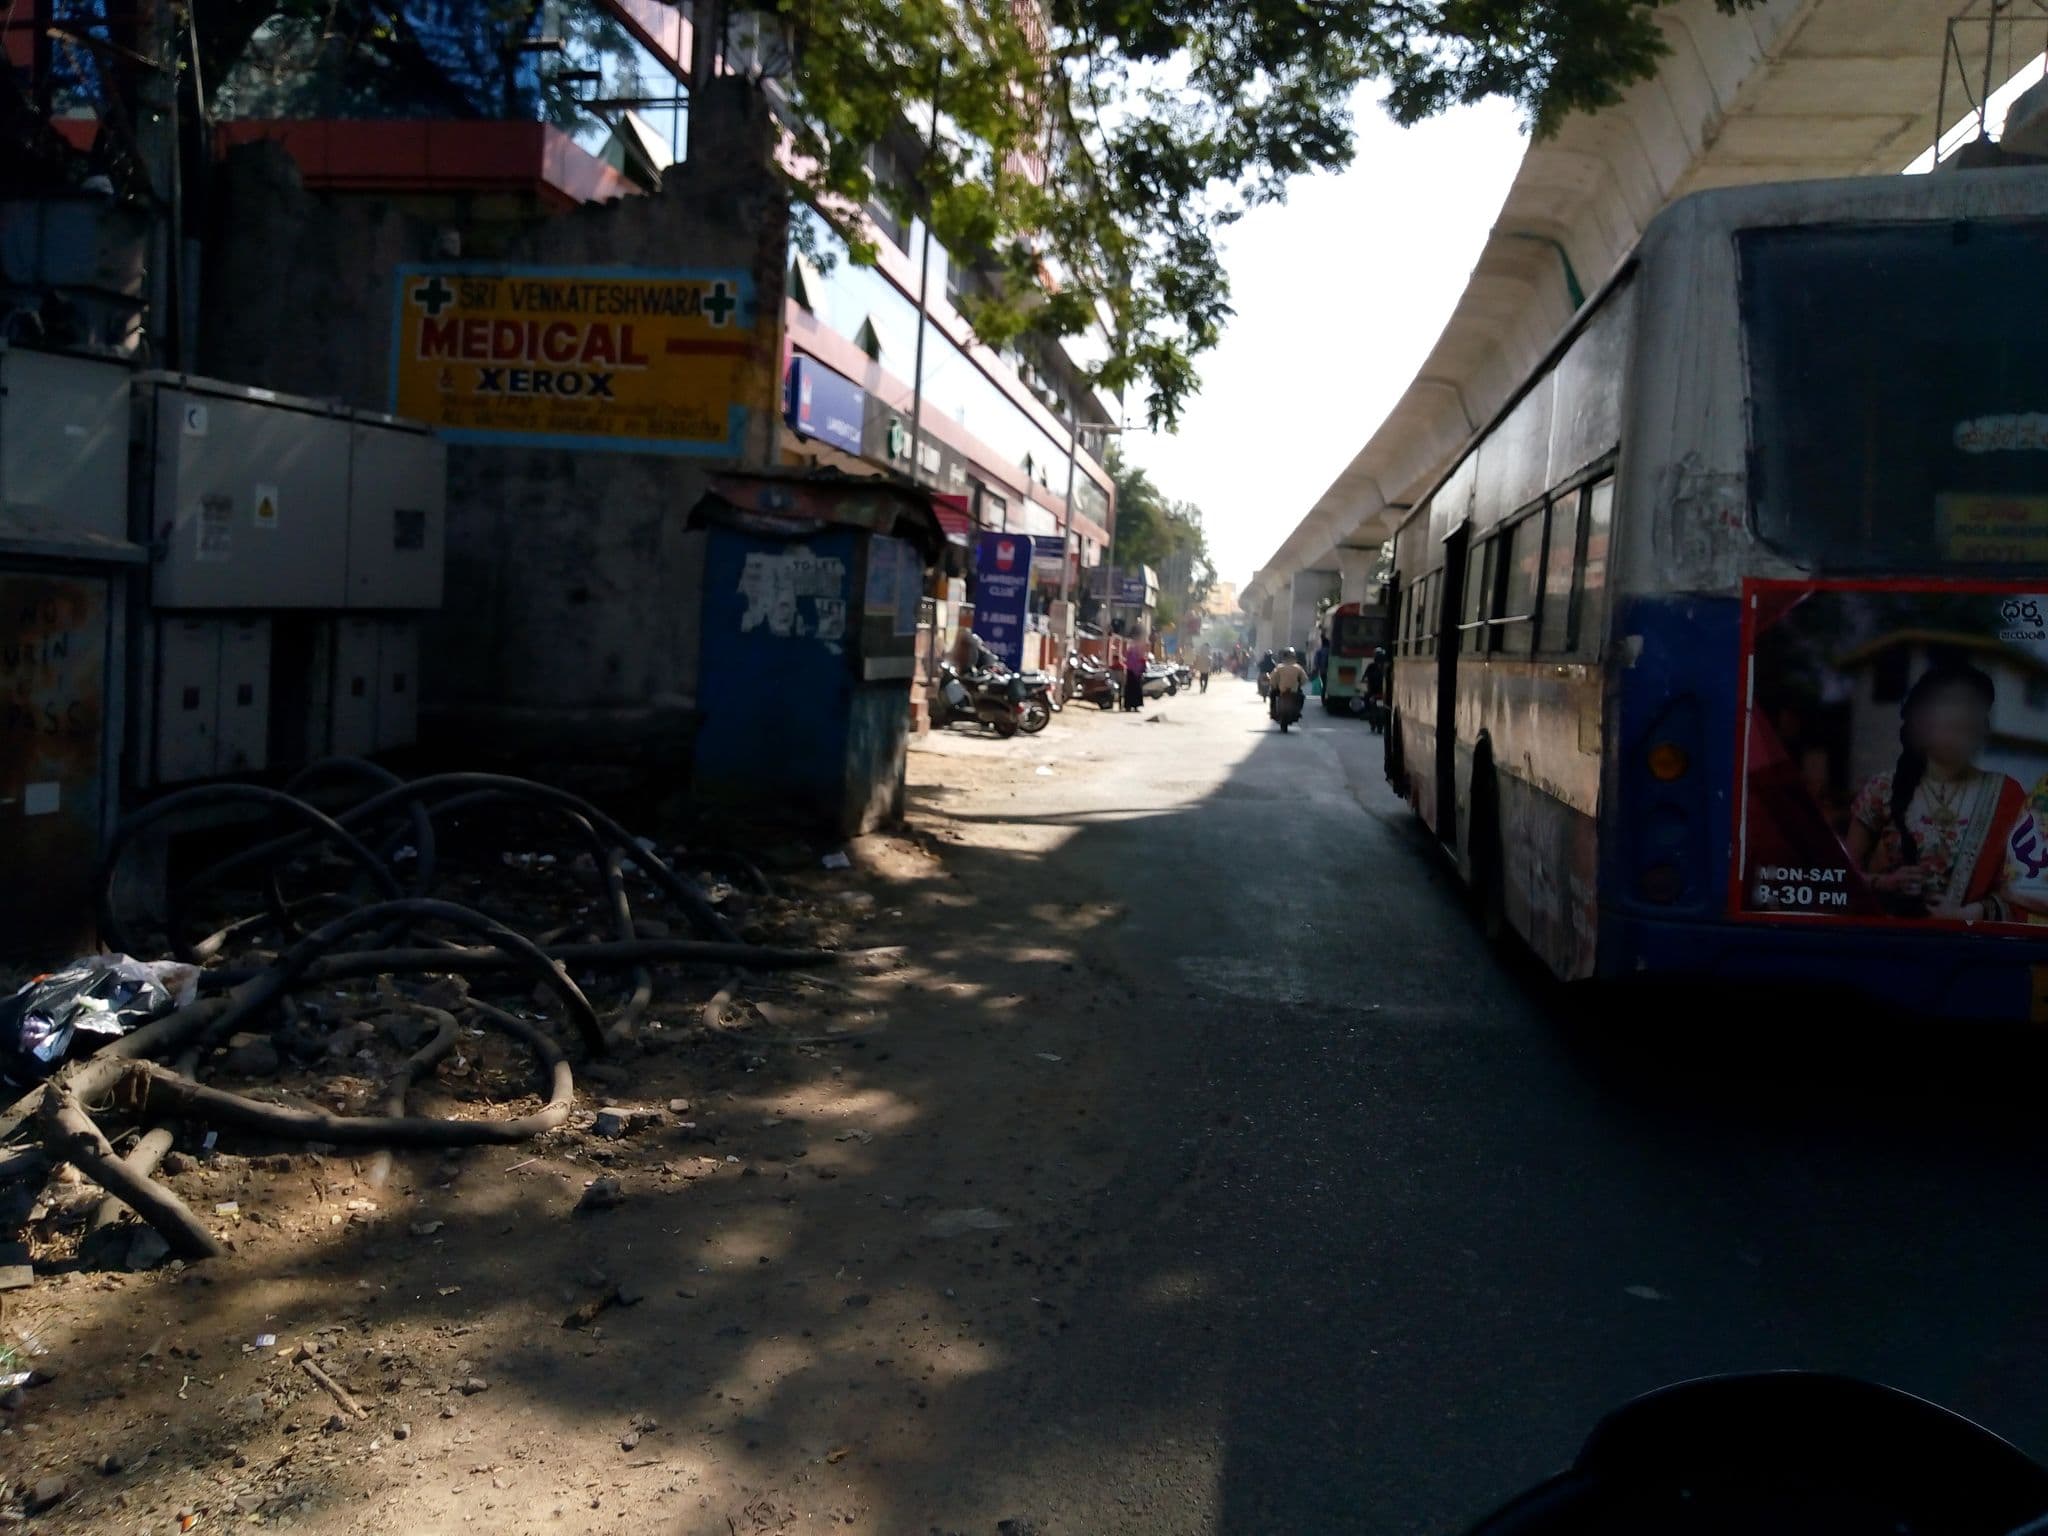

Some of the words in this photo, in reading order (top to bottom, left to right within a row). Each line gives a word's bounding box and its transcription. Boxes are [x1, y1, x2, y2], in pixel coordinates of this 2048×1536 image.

[460, 281, 497, 311] SRI
[509, 281, 702, 316] VENKATESHWARA
[419, 317, 649, 365] MEDICAL
[478, 367, 614, 397] XEROX
[1819, 891, 1848, 905] PM
